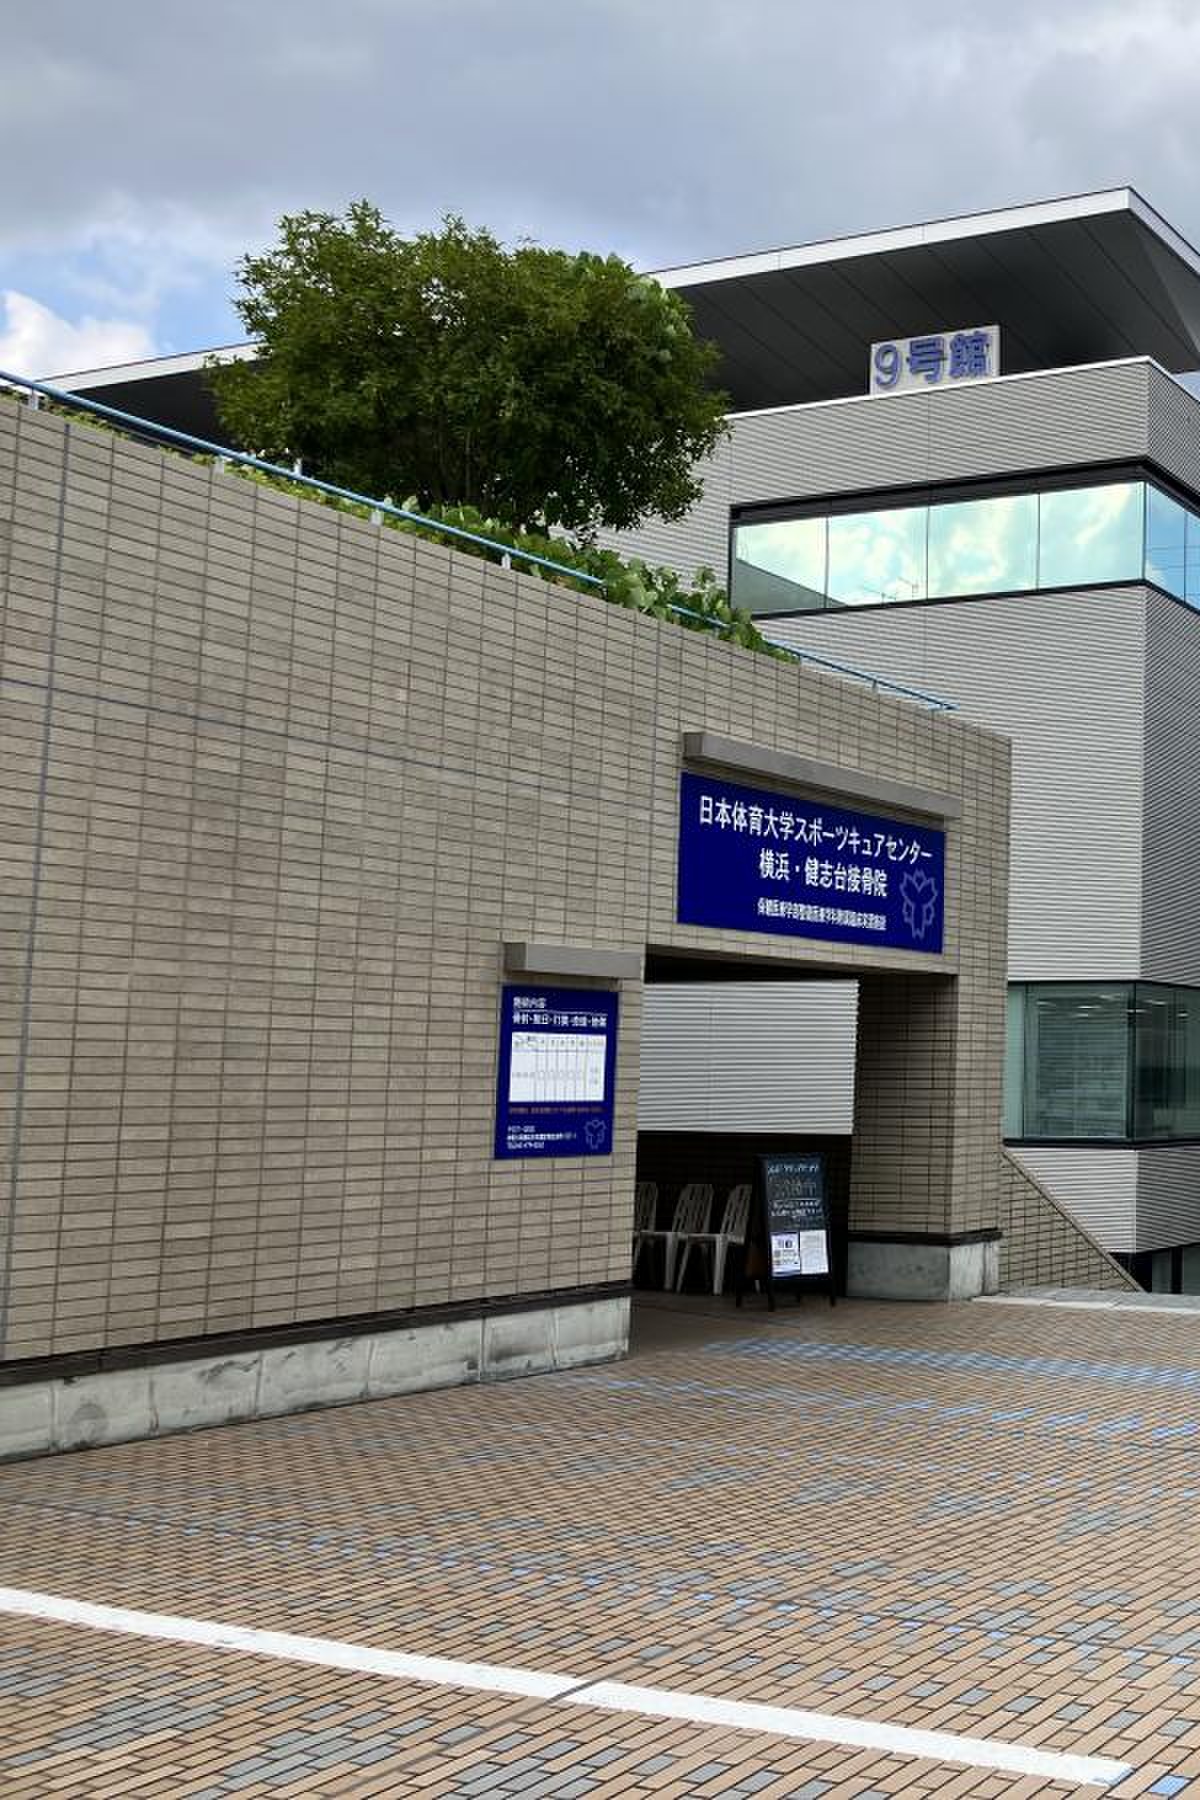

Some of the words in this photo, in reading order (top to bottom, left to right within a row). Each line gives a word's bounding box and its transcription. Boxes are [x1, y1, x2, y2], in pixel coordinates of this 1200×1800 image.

[874, 331, 988, 387] 9号館
[699, 795, 933, 864] 日本体育大学スポーツキュアセンター
[759, 848, 888, 897] 横浜・健志台接骨院
